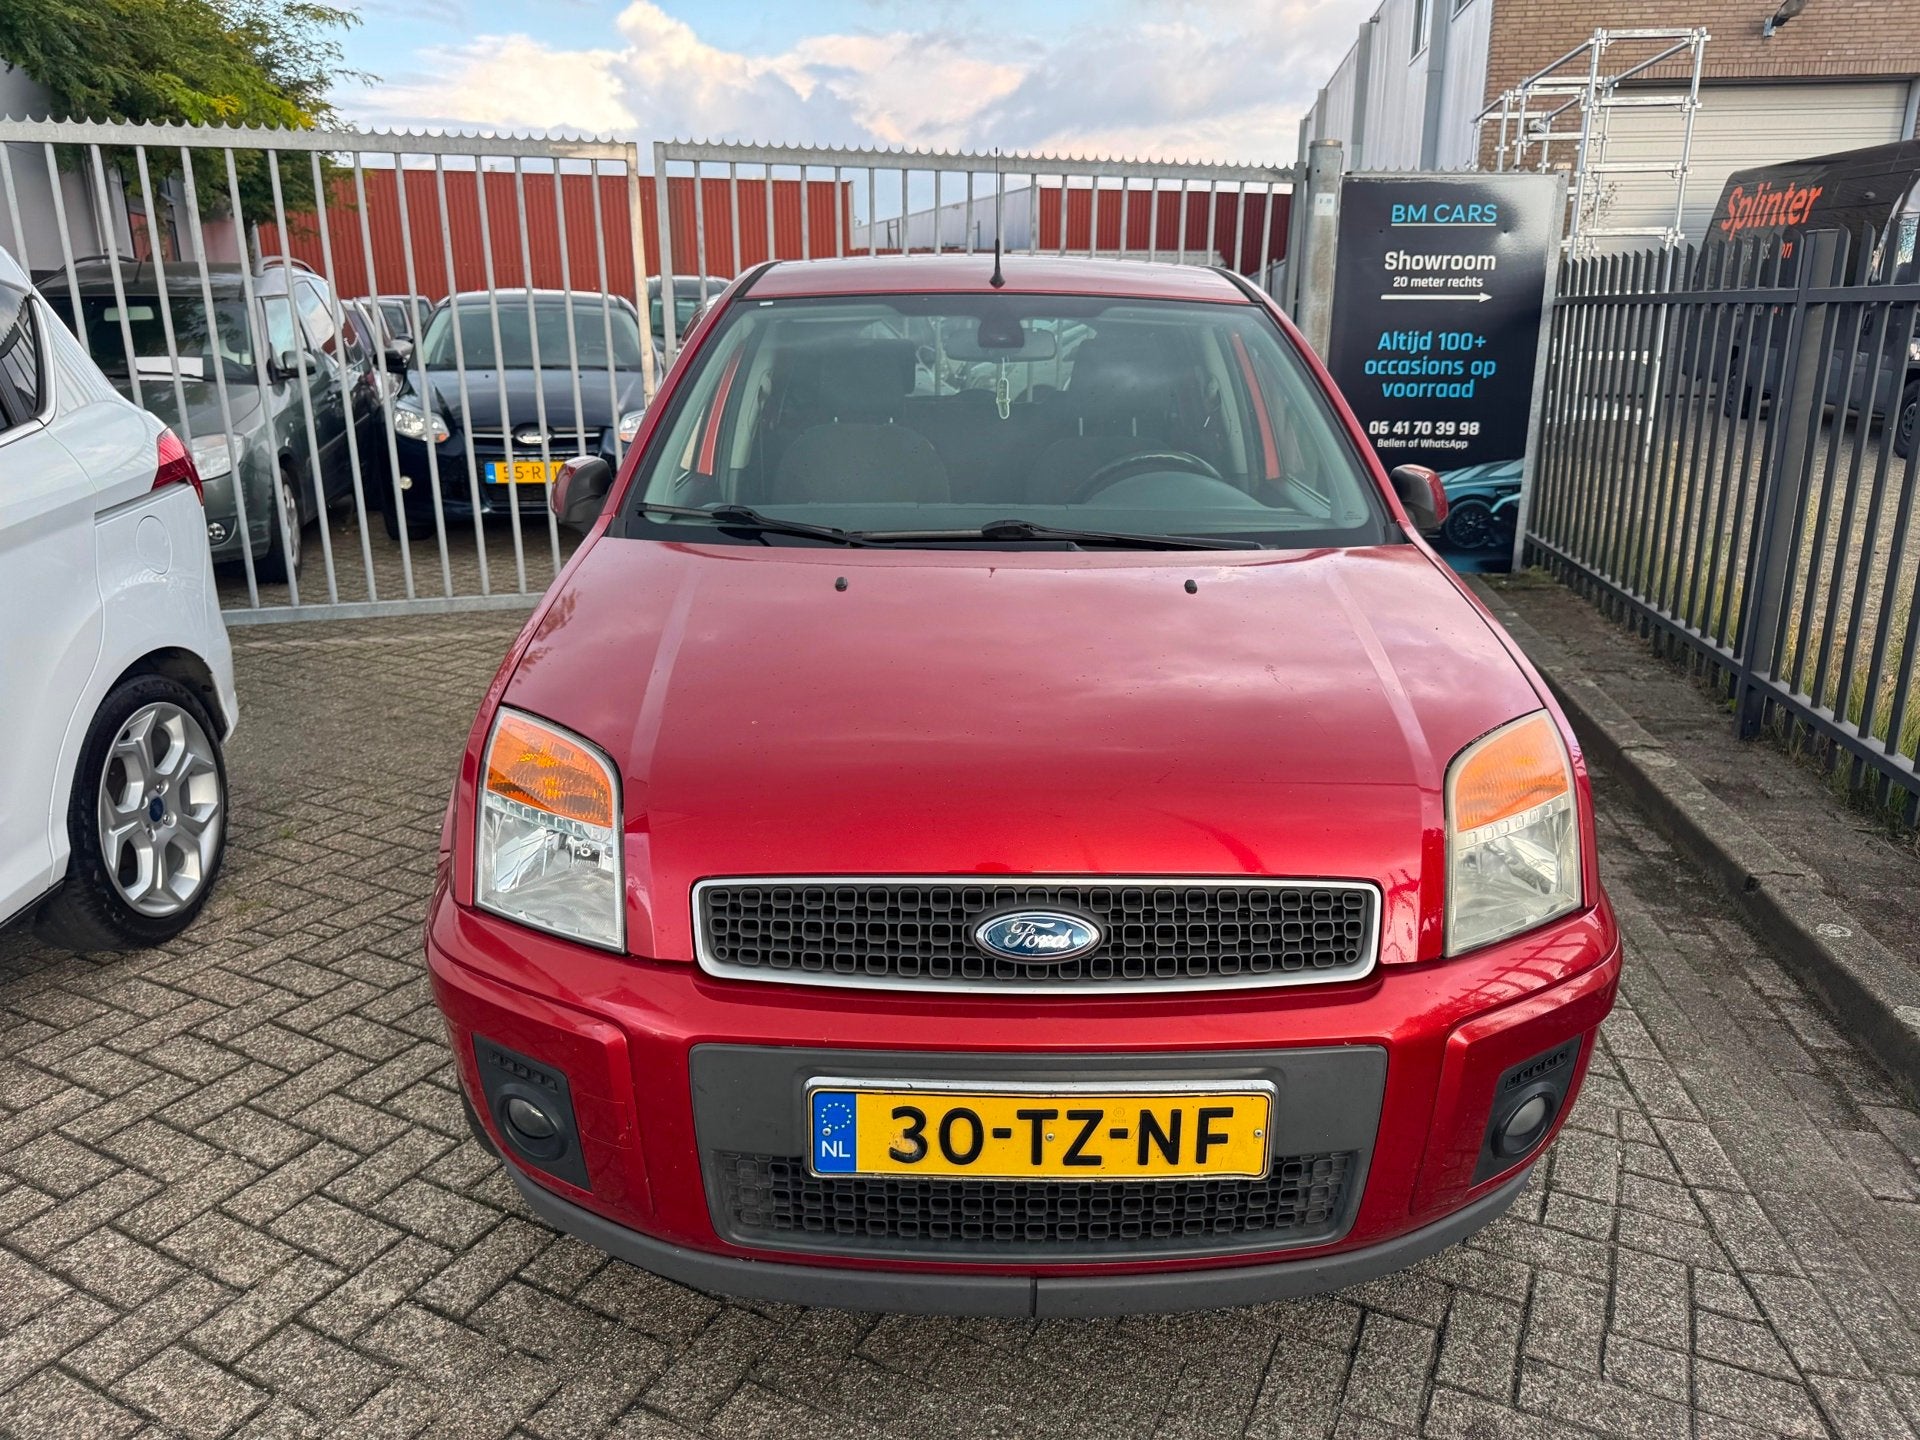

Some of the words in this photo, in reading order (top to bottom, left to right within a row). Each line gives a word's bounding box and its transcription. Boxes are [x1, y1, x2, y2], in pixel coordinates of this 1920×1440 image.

[1391, 204, 1427, 223] BM
[1434, 204, 1498, 223] CARS
[1721, 182, 1823, 242] Splinter
[1384, 250, 1497, 271] Showroom
[1393, 276, 1408, 288] 20
[1411, 276, 1445, 288] meter
[1447, 276, 1484, 288] rechts
[1377, 330, 1433, 355] Altijd
[1438, 332, 1487, 351] 100+
[1364, 355, 1464, 376] occasions
[1470, 360, 1497, 379] op
[1382, 378, 1475, 398] voorraad
[1369, 420, 1389, 435] 06
[1392, 420, 1410, 435] 41
[1413, 420, 1432, 435] 70
[1435, 421, 1456, 436] 39
[1459, 421, 1480, 436] 98
[1377, 438, 1406, 448] Bellen
[1408, 438, 1420, 448] of
[1420, 439, 1469, 450] WhatsApp
[1003, 920, 1073, 949] Ford
[888, 1105, 1234, 1167] 30-TZ-NF
[821, 1140, 851, 1158] NL
